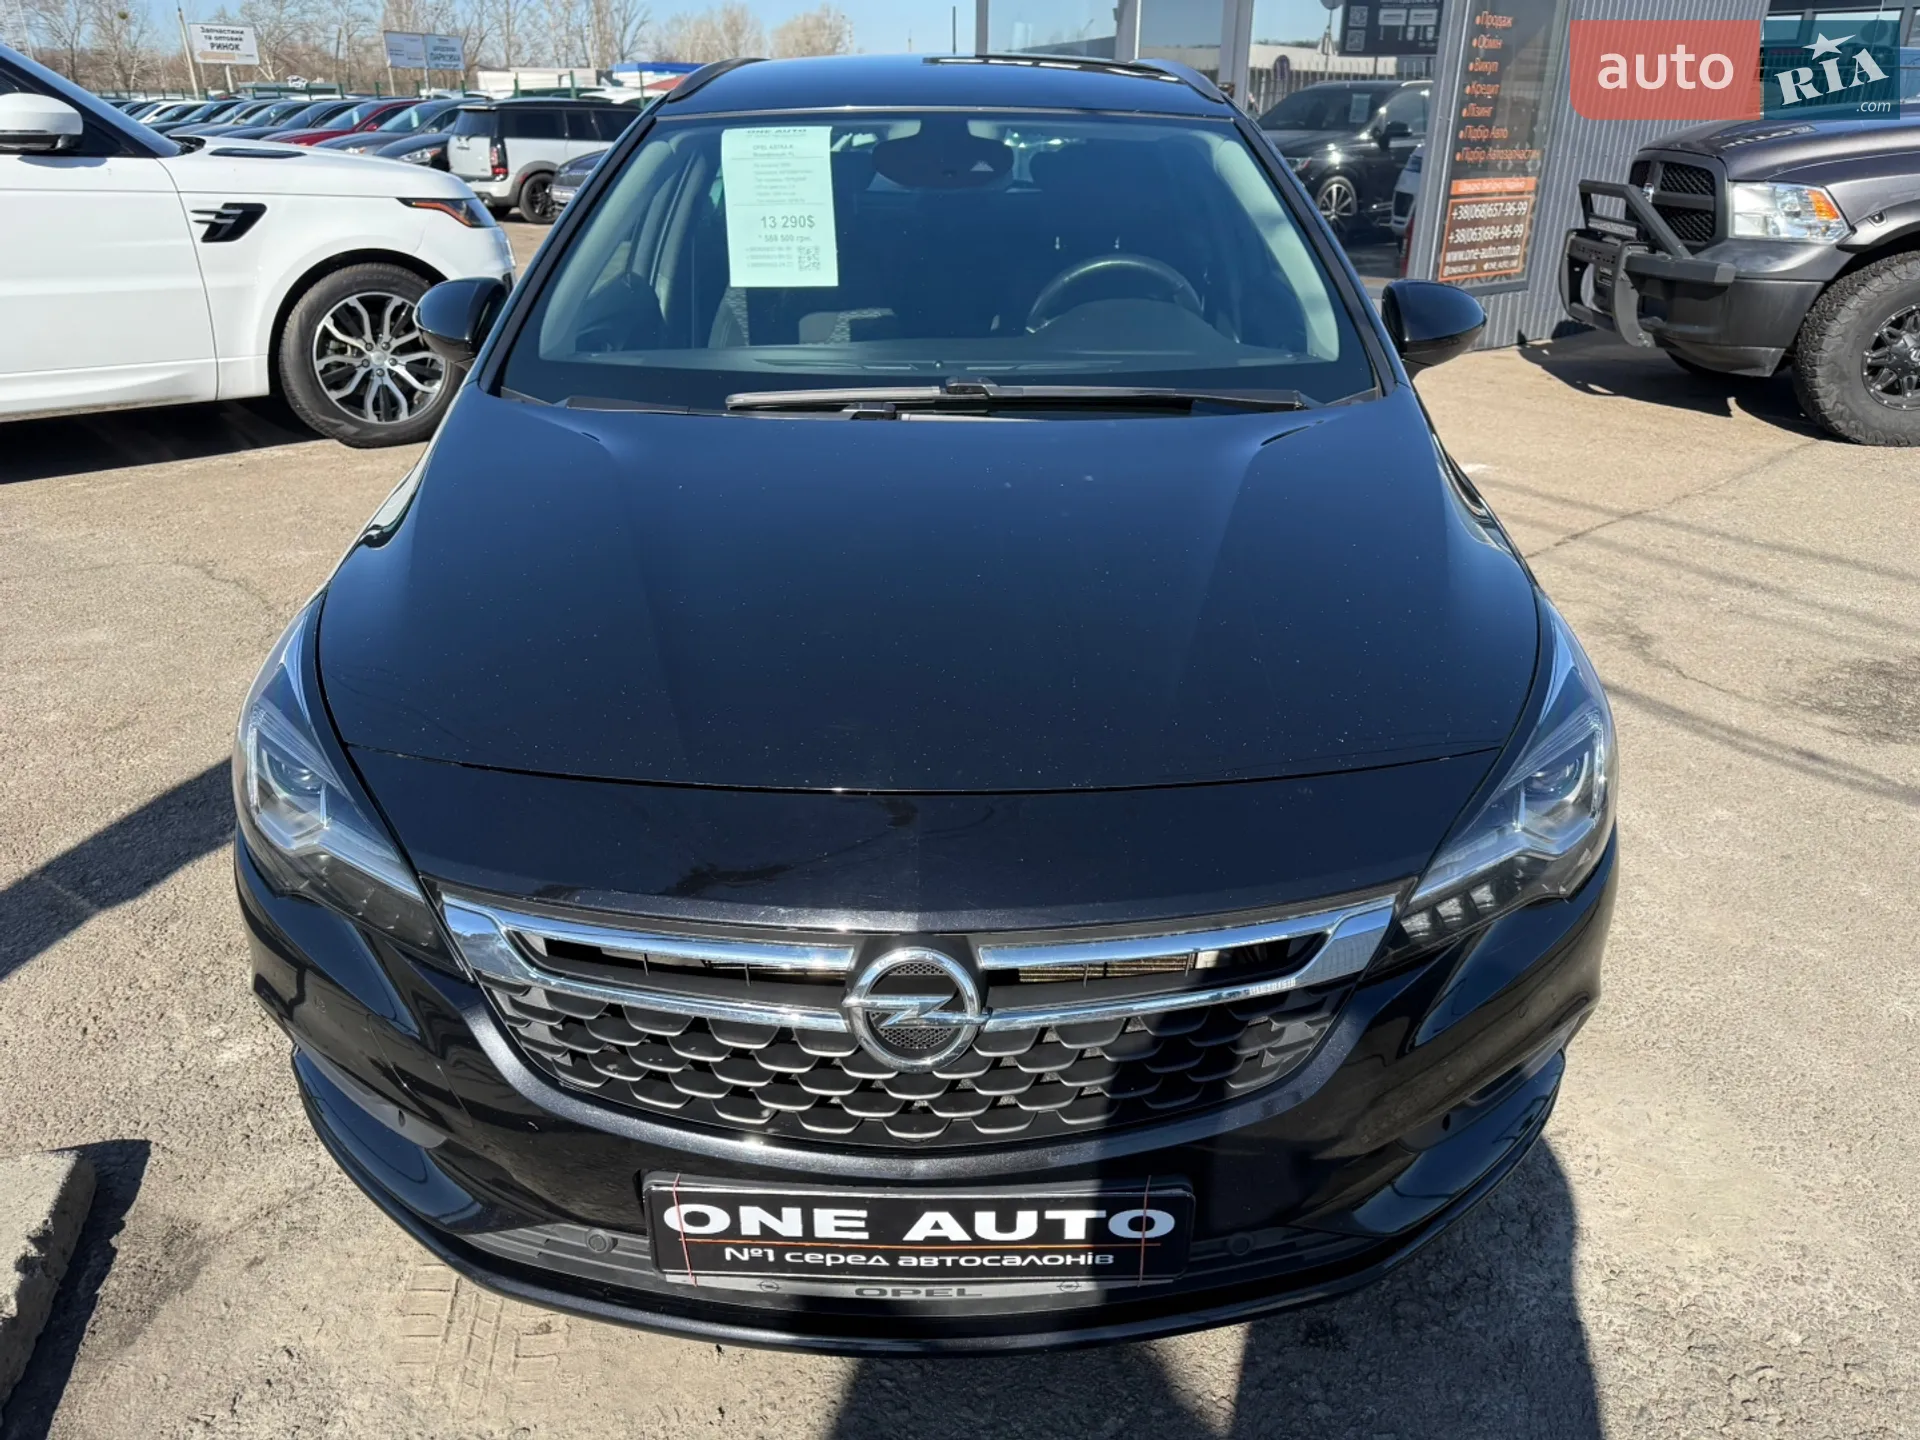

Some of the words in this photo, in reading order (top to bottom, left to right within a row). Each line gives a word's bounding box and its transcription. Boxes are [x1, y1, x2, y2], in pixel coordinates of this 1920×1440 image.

[210, 42, 241, 51] РИНОК
[760, 215, 777, 229] 13
[781, 214, 816, 229] 290$
[663, 1203, 870, 1240] ONE
[902, 1209, 1176, 1242] AUTO
[724, 1247, 775, 1263] №1
[784, 1251, 890, 1267] серед
[897, 1251, 1115, 1268] автосалонів
[855, 1286, 983, 1300] OPEL
